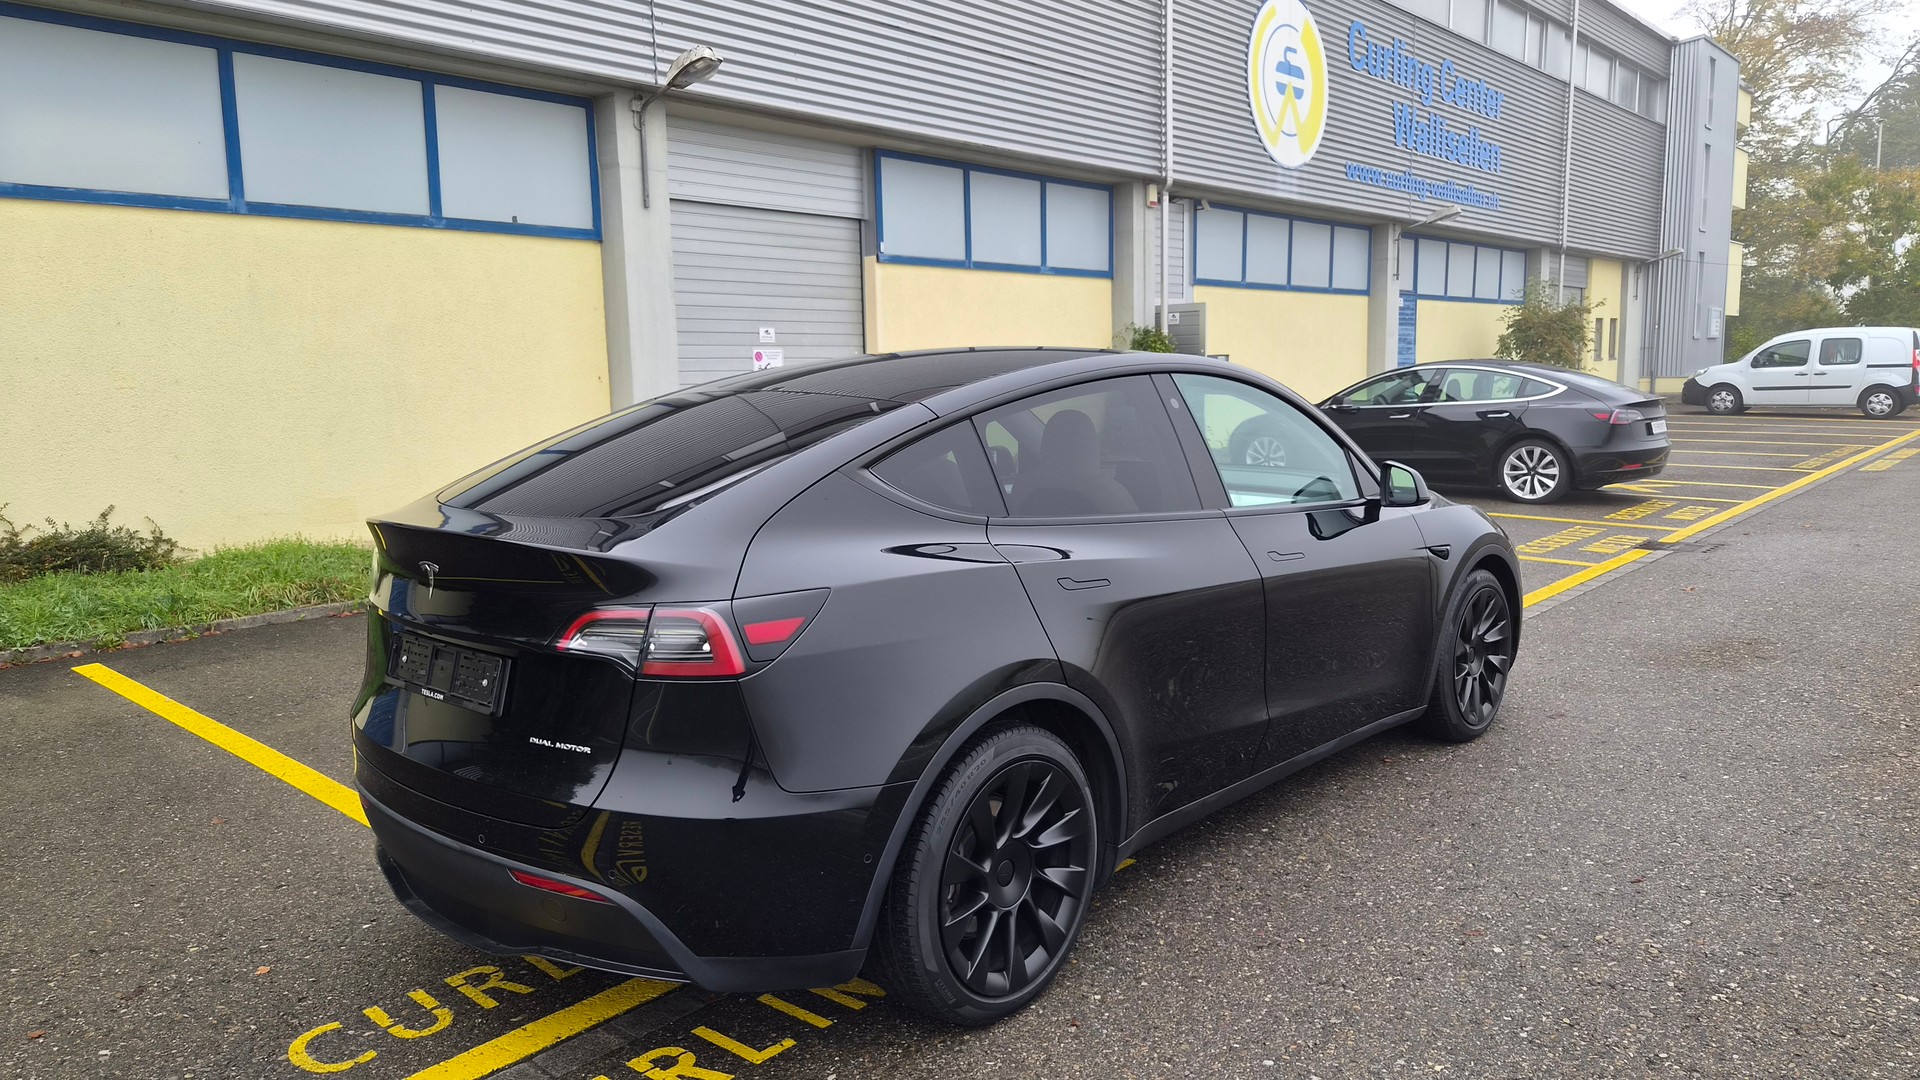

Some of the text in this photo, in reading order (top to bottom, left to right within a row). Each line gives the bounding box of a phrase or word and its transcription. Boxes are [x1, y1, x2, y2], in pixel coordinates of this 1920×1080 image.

[1348, 20, 1505, 119] Curling Center
[1392, 100, 1502, 173] Wallisellen
[1345, 161, 1500, 209] www.curling-wallisellen.ch
[421, 688, 444, 701] TESLA.COM
[529, 736, 592, 754] DUAL MOTOR
[288, 955, 585, 1074] CURL
